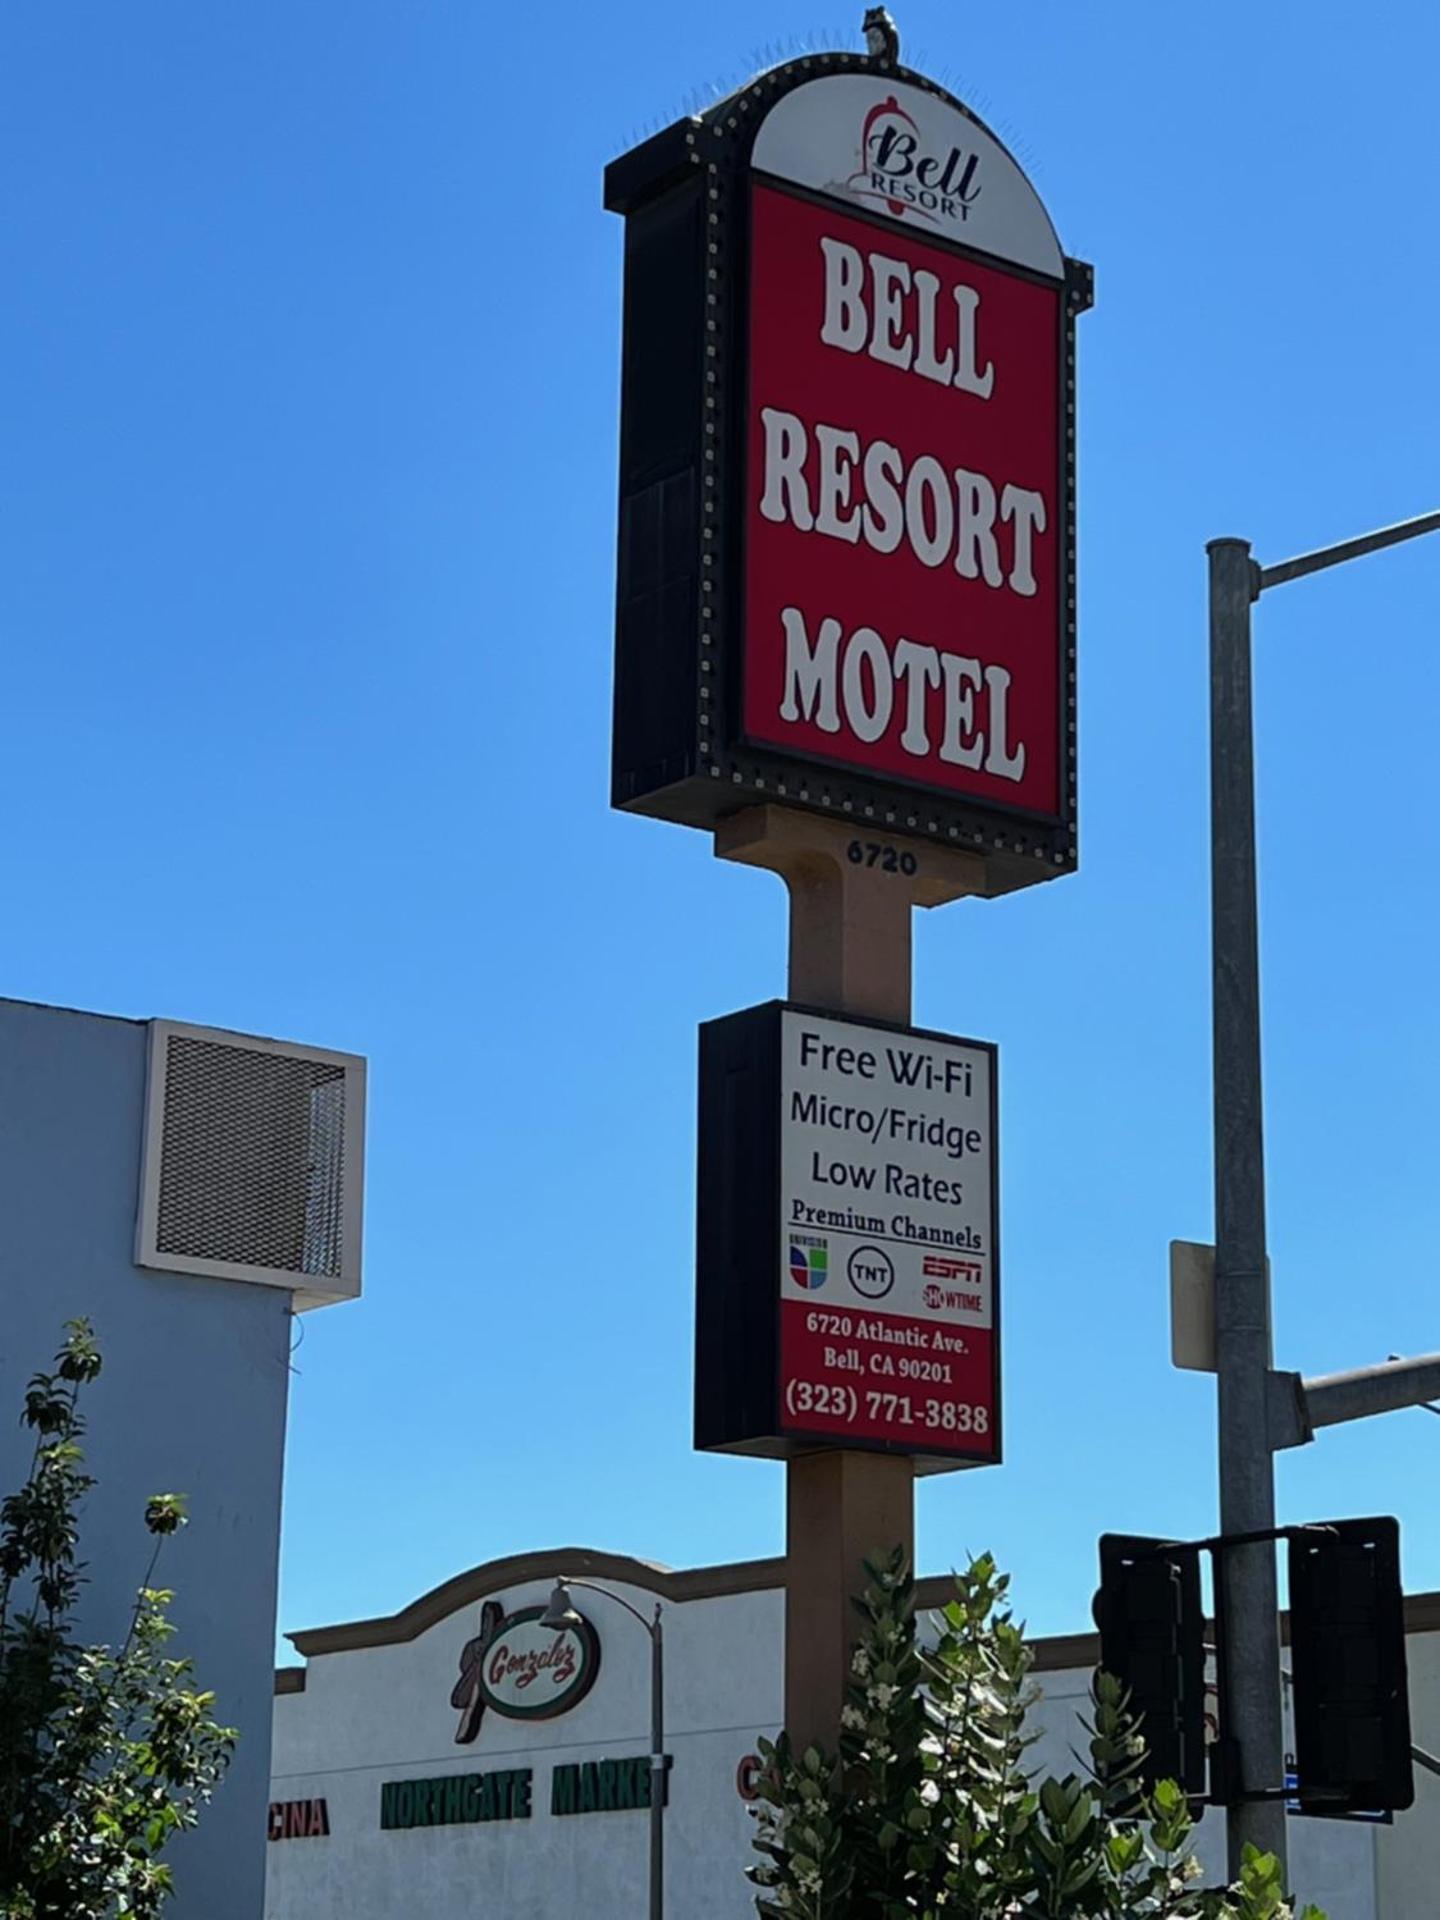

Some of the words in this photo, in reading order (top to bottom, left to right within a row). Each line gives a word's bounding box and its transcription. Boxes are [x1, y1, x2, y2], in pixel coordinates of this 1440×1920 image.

[868, 125, 982, 202] Bell
[871, 171, 971, 221] RESORT
[820, 236, 994, 400] BELL
[760, 407, 1046, 597] RESORT
[779, 608, 1025, 782] MOTEL
[848, 840, 917, 876] 6720
[800, 1032, 876, 1078] Free
[886, 1047, 973, 1097] Wi-Fi
[791, 1091, 982, 1159] Micro/Fridge
[812, 1151, 877, 1190] Low
[885, 1163, 963, 1205] Rates
[791, 1199, 886, 1234] Premium
[891, 1215, 982, 1249] Channels
[854, 1264, 888, 1283] TNT
[922, 1255, 982, 1283] ESPN
[922, 1284, 983, 1312] SHOWTIME
[807, 1312, 851, 1337] 6720
[855, 1319, 928, 1349] Atlantic
[932, 1330, 969, 1355] Ave.
[824, 1346, 865, 1376] Bell,
[869, 1353, 895, 1376] CA
[899, 1361, 953, 1384] 90201
[786, 1378, 858, 1422] (323)
[866, 1391, 988, 1434] 771-3838
[380, 1768, 533, 1830] NORTHGATE
